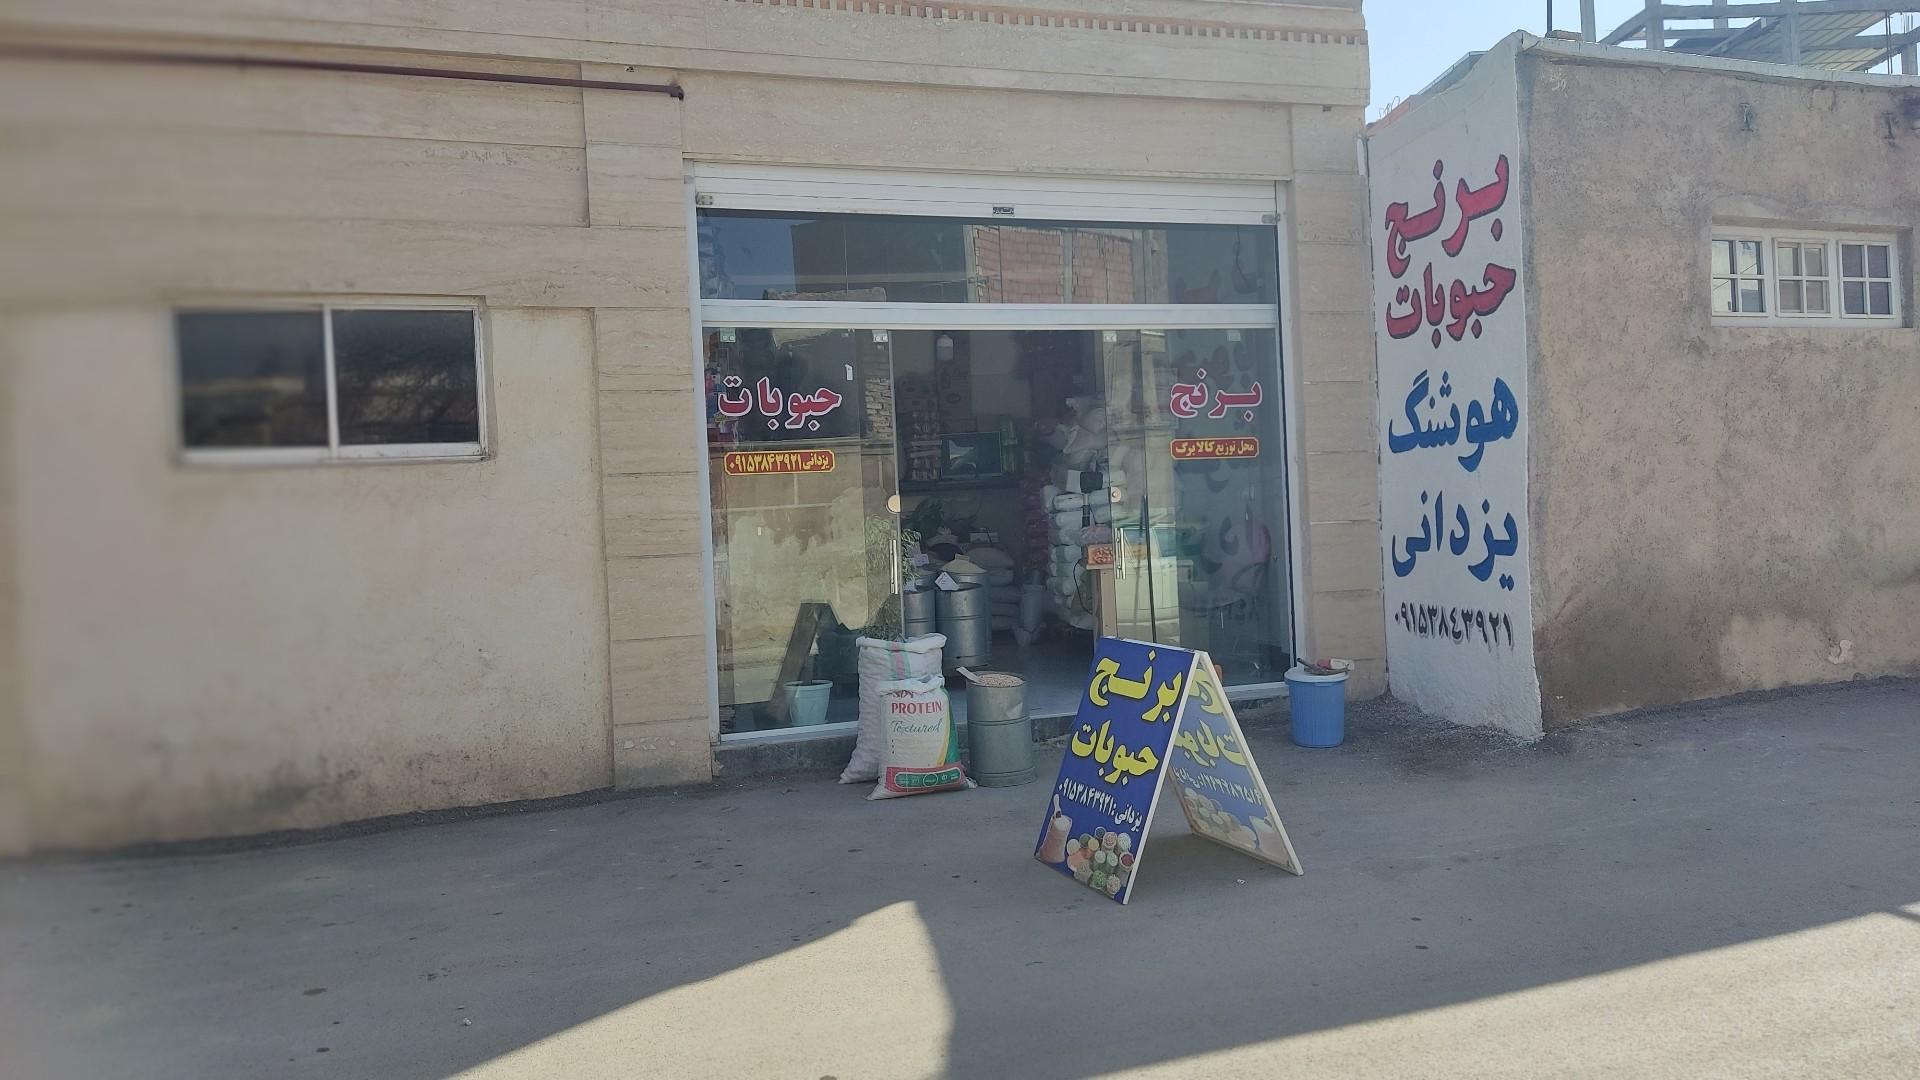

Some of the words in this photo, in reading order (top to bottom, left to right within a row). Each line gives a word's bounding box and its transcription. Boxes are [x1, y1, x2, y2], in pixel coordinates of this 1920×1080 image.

[1385, 154, 1509, 279] برنج
[1386, 262, 1517, 349] حبوبات
[718, 376, 842, 431] حبوبات
[1170, 367, 1263, 423] برنج
[1389, 369, 1519, 473] هوشنگ
[802, 453, 830, 470] یزدانی
[1215, 440, 1236, 456] توزیع
[1237, 440, 1255, 455] محل
[1391, 490, 1519, 592] یزدانی
[891, 701, 942, 715] PROTEIN
[1089, 650, 1182, 722] برنج
[891, 718, 943, 736] Textured
[1072, 720, 1159, 785] حبوبات
